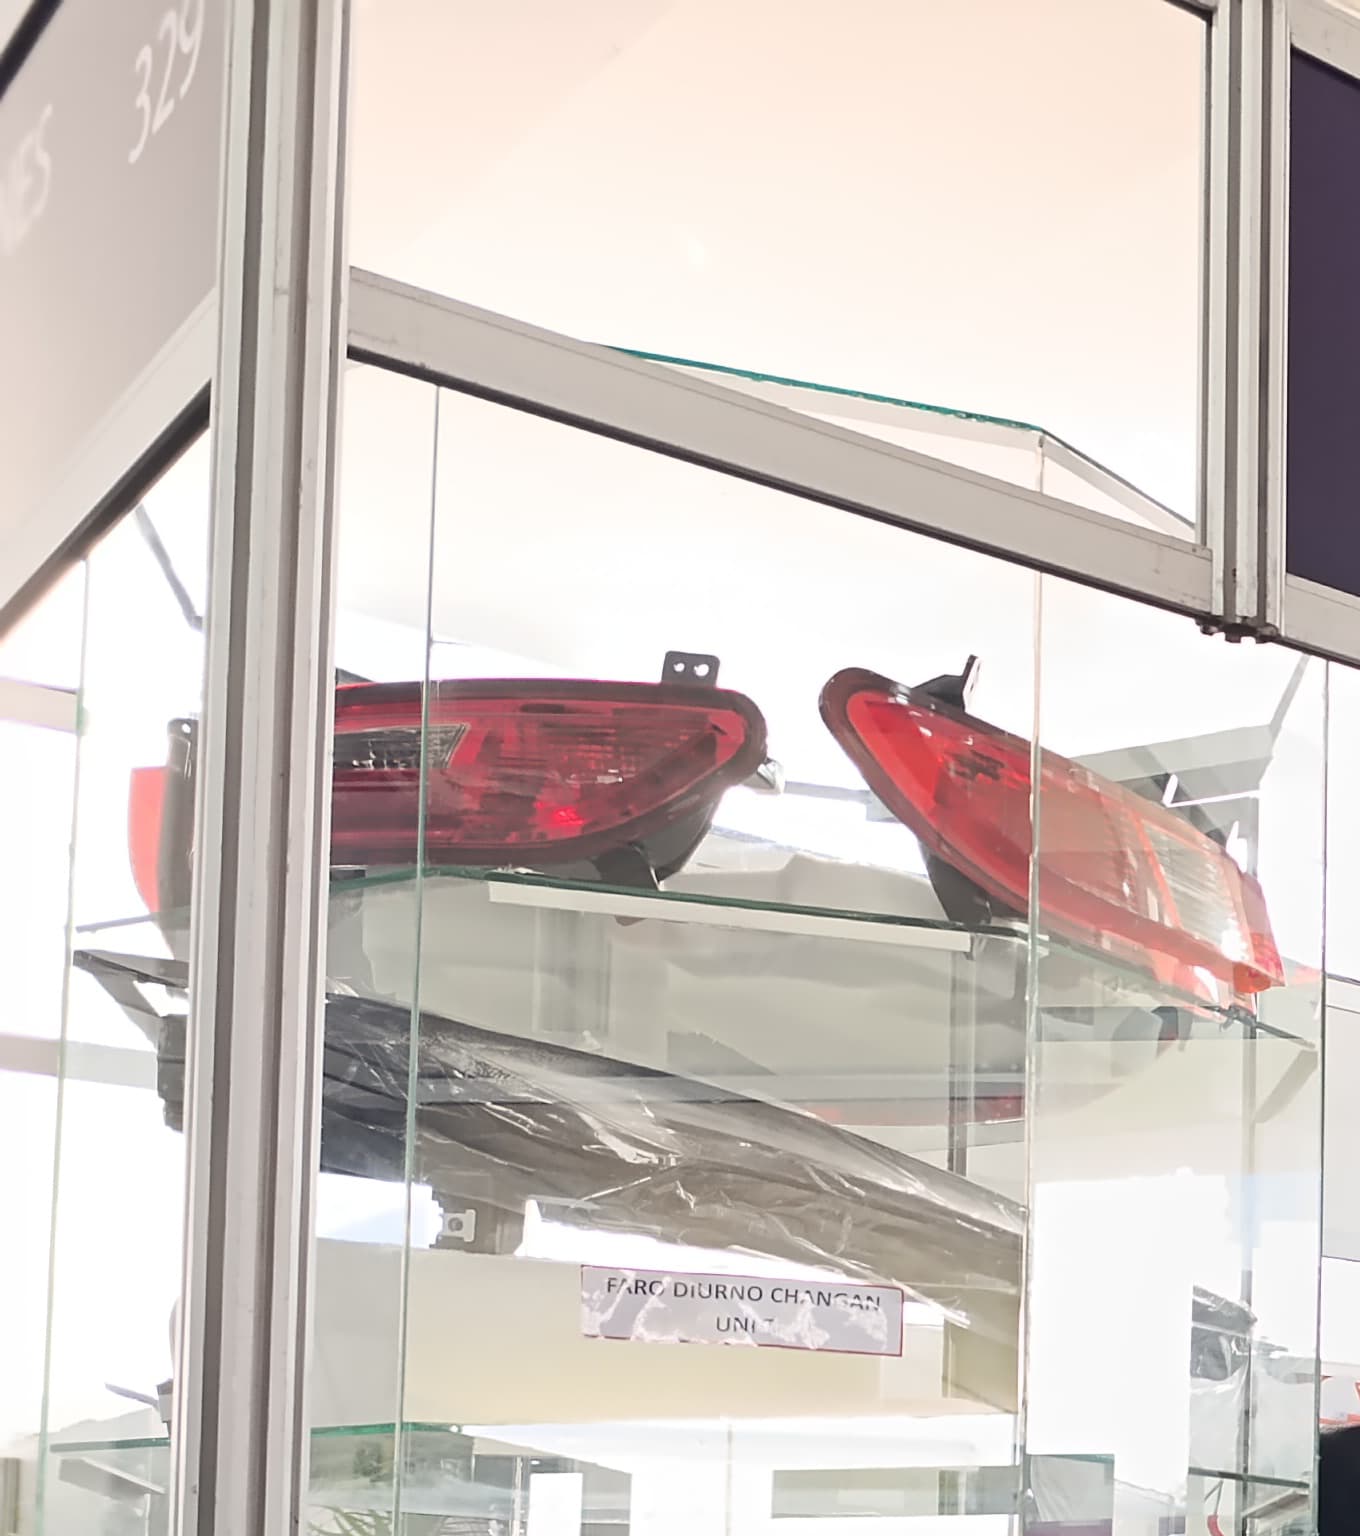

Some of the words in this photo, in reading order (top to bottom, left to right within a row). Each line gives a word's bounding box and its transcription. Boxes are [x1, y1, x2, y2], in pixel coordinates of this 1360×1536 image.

[128, 0, 206, 164] 329
[606, 1276, 665, 1297] FARO
[770, 1286, 881, 1312] CHANGAN
